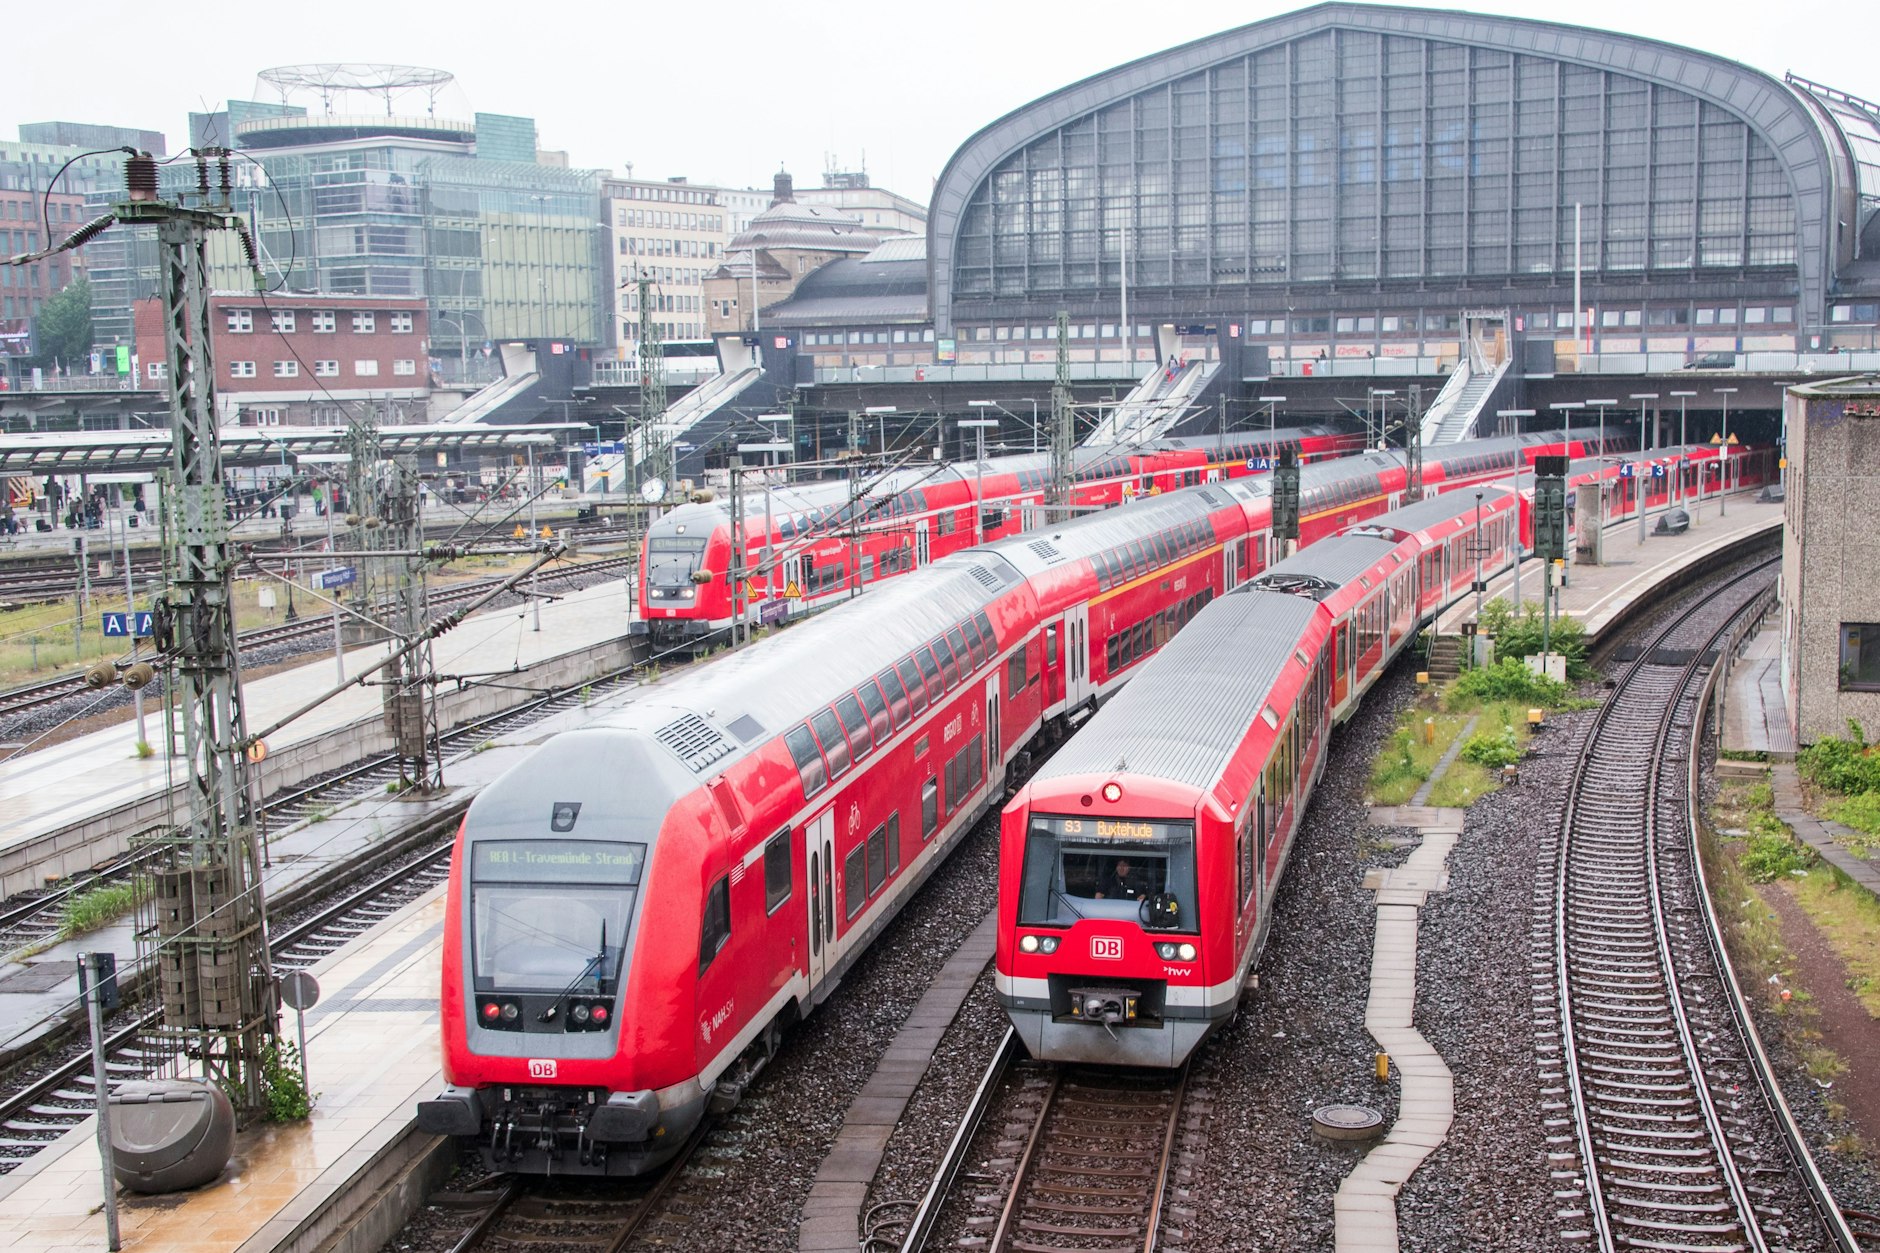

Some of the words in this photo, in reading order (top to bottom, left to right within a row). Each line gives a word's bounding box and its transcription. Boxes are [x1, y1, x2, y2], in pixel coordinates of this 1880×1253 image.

[1247, 458, 1254, 469] 6
[1260, 458, 1267, 469] A
[1620, 465, 1628, 476] 4
[1656, 465, 1664, 476] 3
[107, 614, 122, 633] A
[943, 719, 957, 744] REGIO
[1064, 820, 1081, 833] S3
[1096, 821, 1152, 838] Buxtehude
[490, 851, 509, 863] RE8
[595, 852, 633, 865] Strand
[1094, 940, 1119, 956] DB
[1168, 966, 1192, 976] hvv
[532, 1062, 554, 1076] DB
